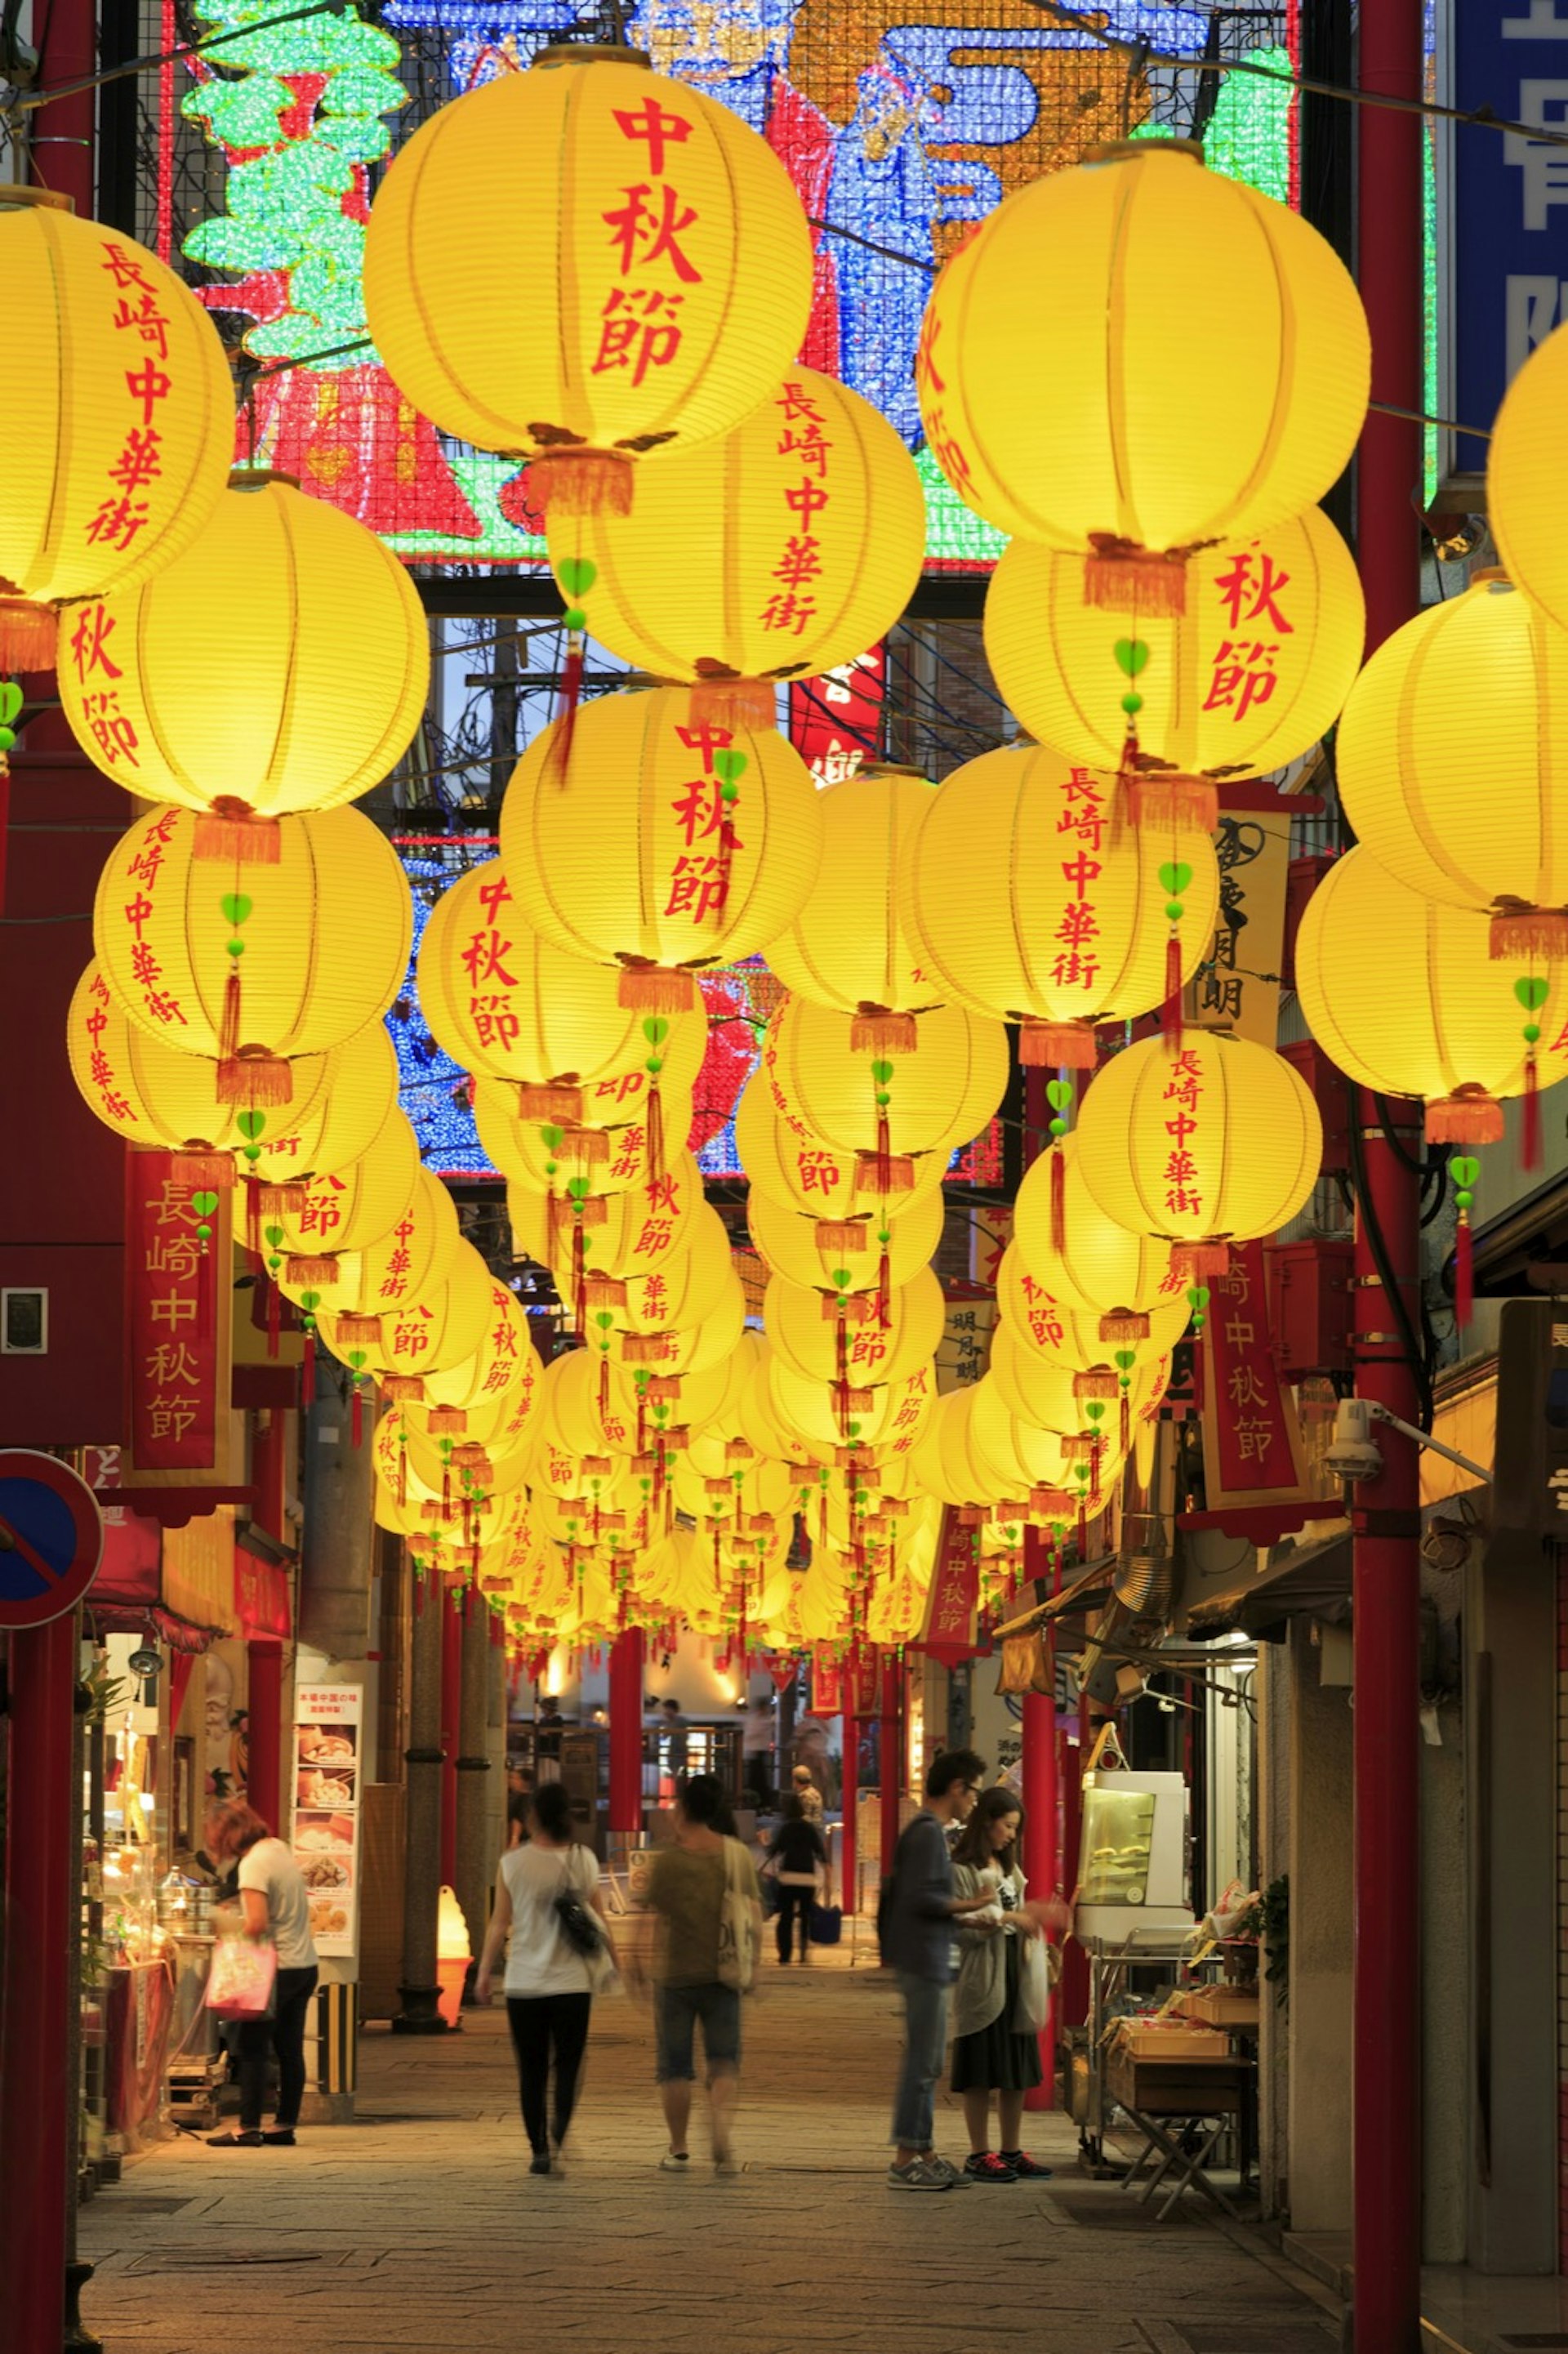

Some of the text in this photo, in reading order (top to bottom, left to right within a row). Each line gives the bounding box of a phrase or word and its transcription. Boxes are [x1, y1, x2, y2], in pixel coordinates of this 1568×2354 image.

[590, 96, 702, 388] 中秋節
[85, 243, 172, 551] 長崎中華街
[759, 381, 833, 636] 長崎中華街
[70, 603, 140, 769] 秋節
[1202, 540, 1294, 722] 秋節
[664, 718, 744, 925] 中秋節
[1049, 766, 1107, 991] 長崎中華街
[124, 808, 188, 1026] 長崎中華街
[461, 874, 520, 1054] 中秋節
[634, 1171, 681, 1258] 秋節
[1163, 1050, 1205, 1217] 長崎中華街
[145, 1179, 202, 1443] 長崎中秋節
[379, 1209, 415, 1300] 中華街
[481, 1286, 519, 1394] 中秋節
[596, 1395, 626, 1443] 節
[1218, 1242, 1273, 1463] 崎中秋節
[506, 1508, 532, 1568] 秋節
[938, 1511, 970, 1633] 崎中秋節
